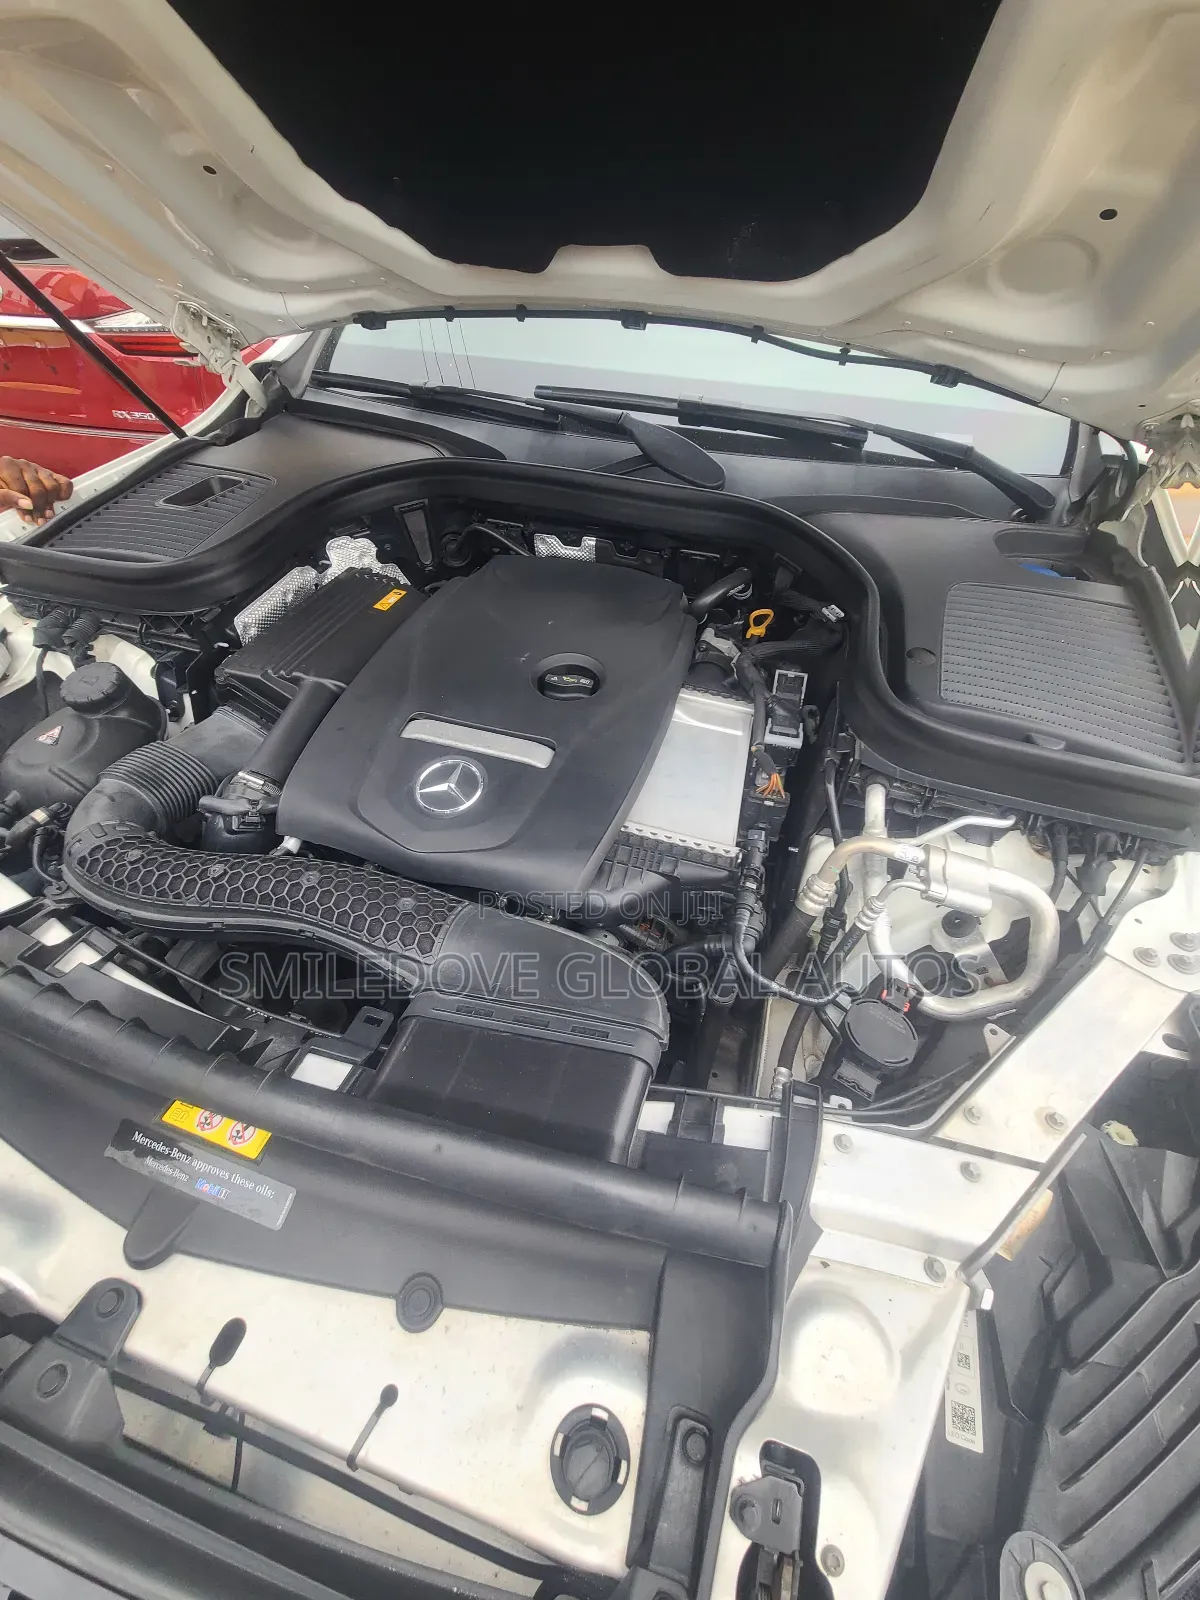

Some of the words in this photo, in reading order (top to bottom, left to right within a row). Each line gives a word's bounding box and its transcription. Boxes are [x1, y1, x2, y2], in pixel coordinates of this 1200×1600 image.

[131, 1130, 192, 1164] Mercedes-Benz
[191, 1158, 231, 1180] approves
[231, 1172, 255, 1190] these
[143, 1155, 190, 1182] Mercedes-Benz
